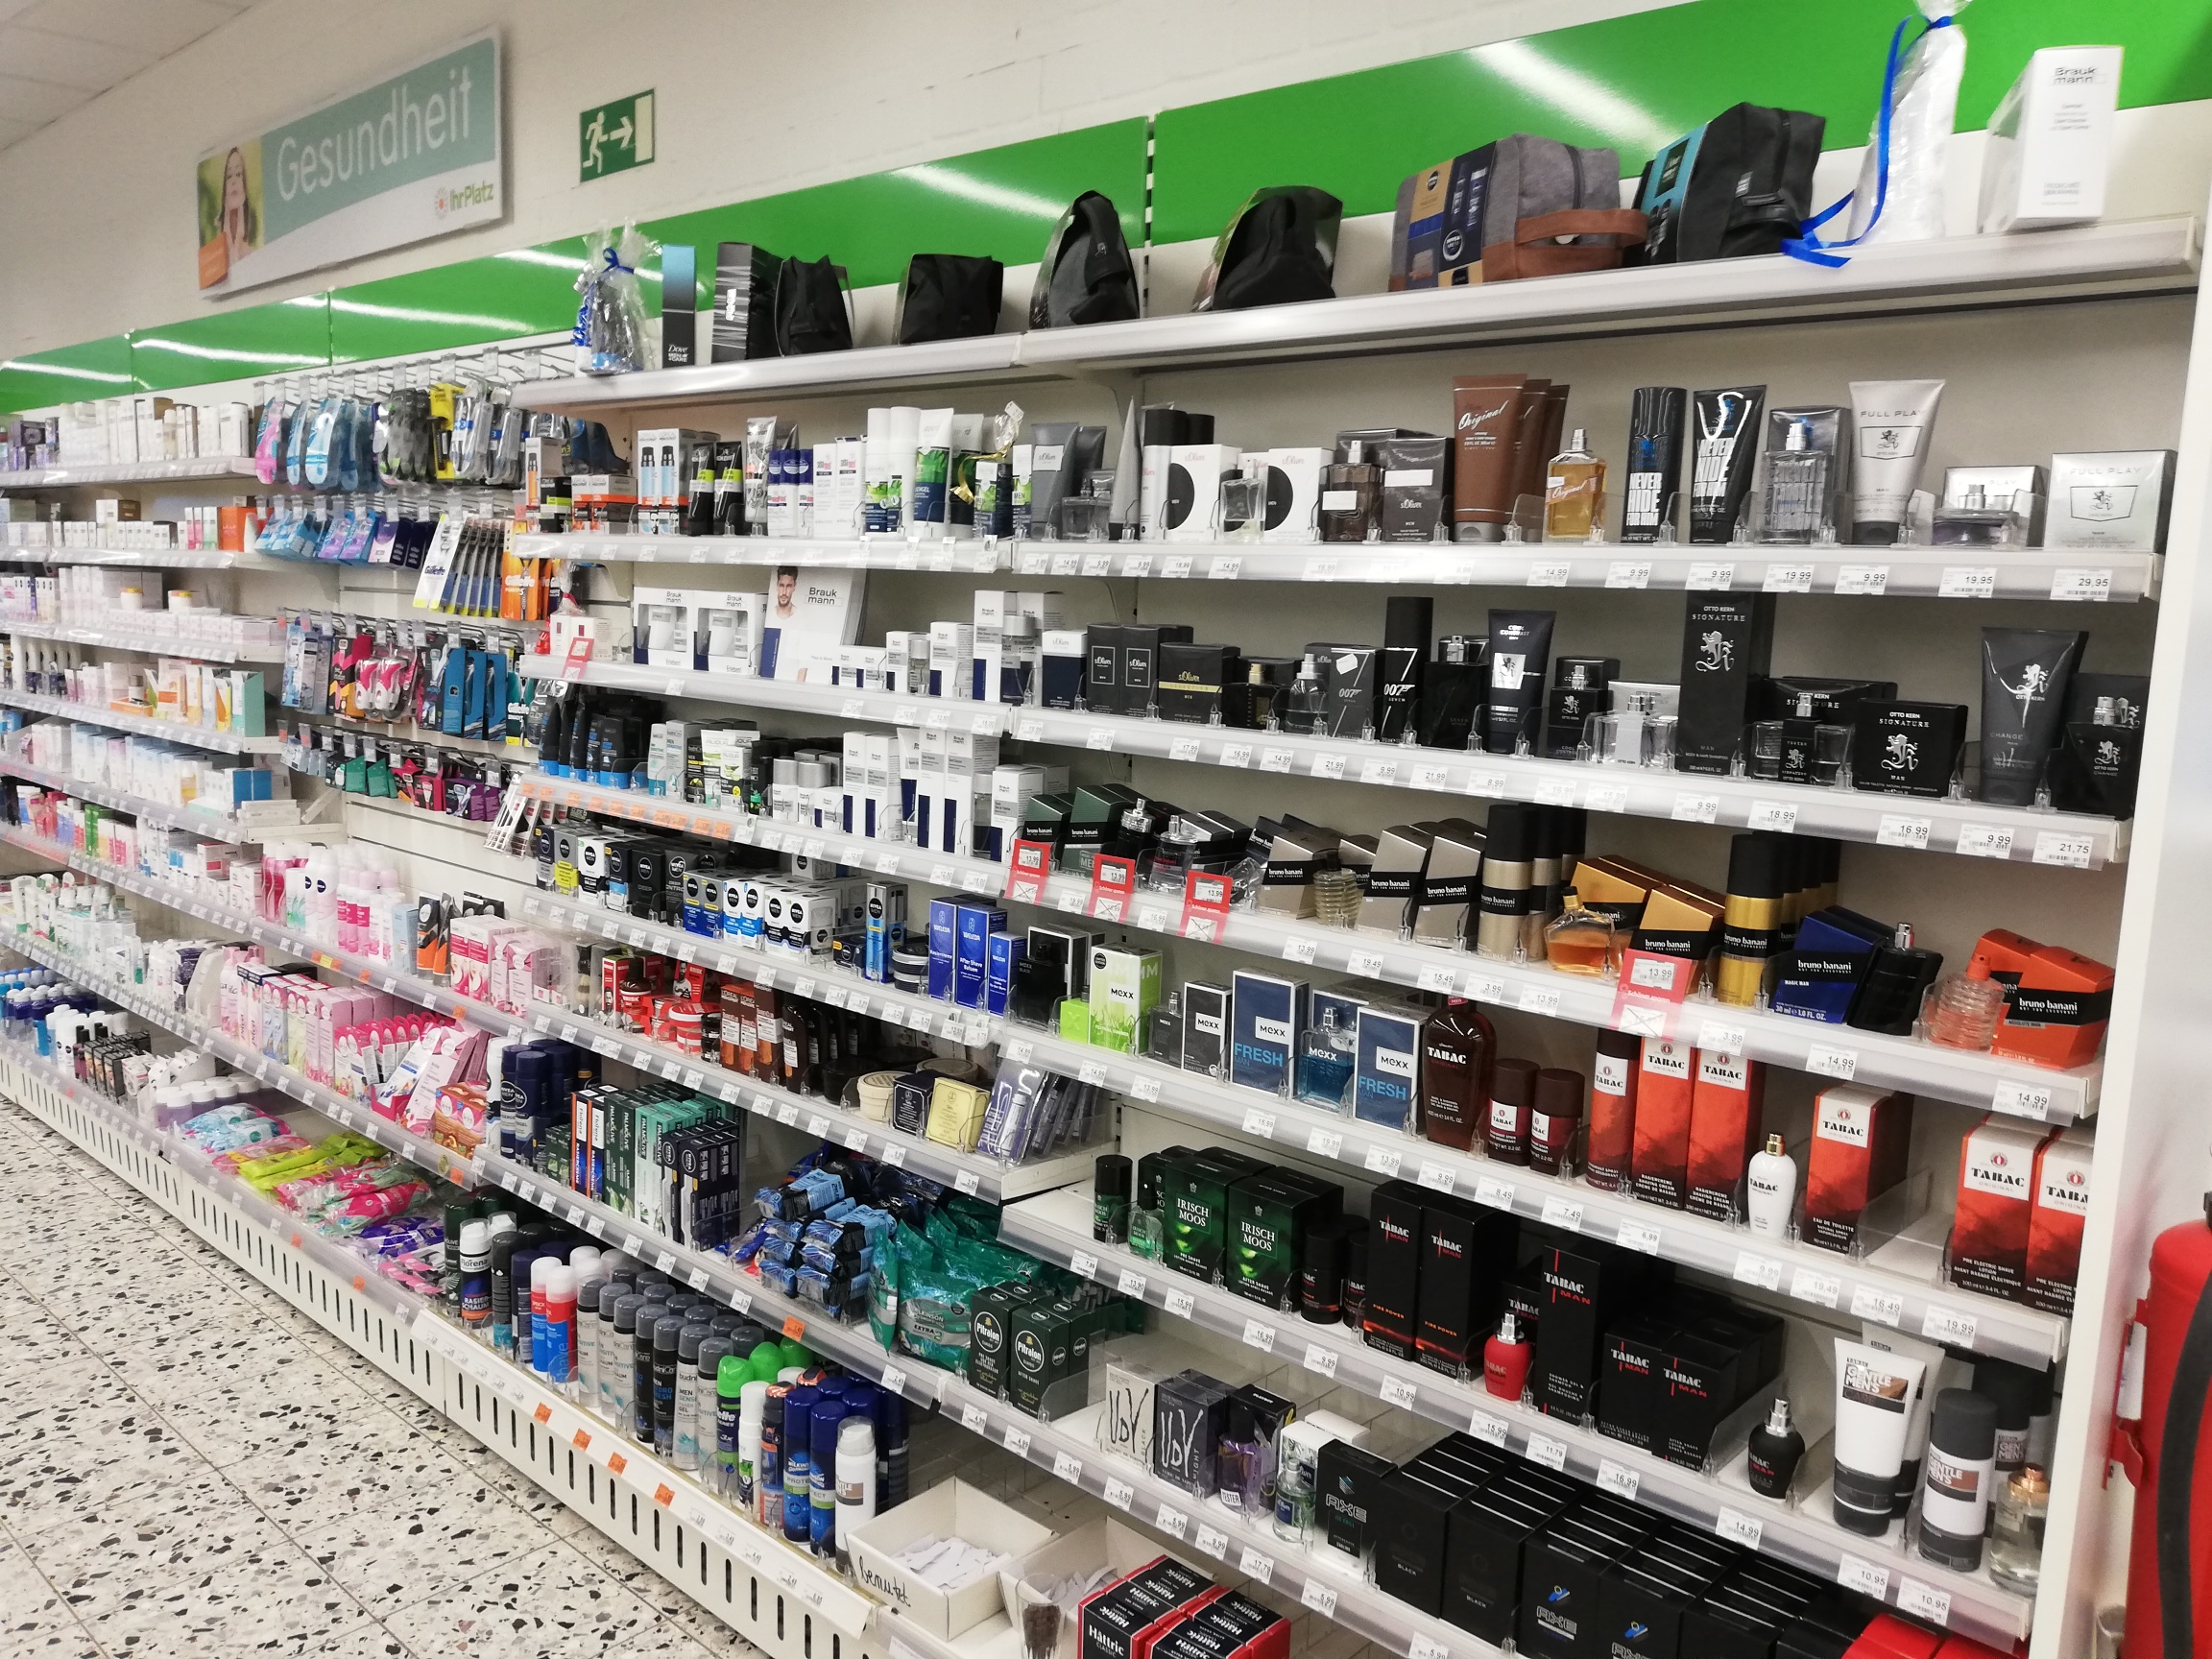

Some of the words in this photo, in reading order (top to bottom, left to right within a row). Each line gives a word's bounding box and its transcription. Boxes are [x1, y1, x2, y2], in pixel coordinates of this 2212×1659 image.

[2055, 66, 2098, 76] Brauk
[277, 66, 472, 201] Gesundheit
[449, 181, 493, 212] IhrPlatz
[668, 344, 688, 352] Dove
[1457, 400, 1510, 431] Original
[2069, 468, 2104, 476] FULL
[2107, 467, 2143, 475] PLAY
[1629, 472, 1663, 490] NEVER
[1014, 492, 1026, 500] MEN
[1551, 483, 1586, 500] Original
[1627, 489, 1661, 514] HIDE
[1641, 513, 1660, 527] HIM
[1221, 563, 1240, 572] 14.99
[1545, 567, 1568, 578] 14.99
[1629, 567, 1649, 577] 9.99
[1711, 570, 1732, 580] 9.99
[1784, 571, 1812, 581] 19.99
[1863, 573, 1887, 584] 9.99
[1964, 575, 1994, 586] 19,95
[2077, 577, 2109, 588] 29,95
[726, 594, 743, 603] Brauk
[808, 587, 838, 599] Brauk
[806, 596, 836, 606] mann
[1692, 613, 1746, 623] SIGNATURE
[1177, 670, 1201, 684] s.Oliver
[1879, 718, 1930, 729] SIGNATURE
[1989, 732, 2024, 741] CHANGE
[1425, 771, 1446, 781] 21.99
[1696, 802, 1718, 812] 9.99
[1768, 809, 1795, 821] 18.99
[1899, 825, 1929, 837] 16.99
[1986, 835, 2011, 847] 9.99
[2058, 842, 2090, 855] 21,75
[1109, 871, 1127, 881] 13.99
[1268, 867, 1284, 876] bruno
[1284, 868, 1304, 877] banani
[1371, 878, 1389, 889] bruno
[1389, 879, 1410, 889] banani
[1427, 886, 1445, 895] bruno
[1445, 885, 1467, 895] banani
[1207, 888, 1224, 899] 13.99
[1645, 939, 1666, 949] bruno
[1666, 940, 1691, 950] banani
[1725, 933, 1742, 944] bruno
[1742, 936, 1767, 947] banani
[1297, 943, 1315, 955] 13.99
[1362, 956, 1382, 969] 19.49
[1797, 959, 1822, 971] bruno
[1823, 960, 1852, 973] banani
[1433, 972, 1455, 984] 15.49
[1648, 966, 1673, 978] 13.99
[1484, 982, 1502, 994] 3.99
[1536, 993, 1558, 1006] 13.99
[2018, 997, 2045, 1009] bruno
[2046, 999, 2079, 1012] banani
[1721, 1031, 1743, 1044] 3.99
[1235, 1043, 1285, 1069] FRESH
[1427, 1046, 1468, 1066] TABAC
[1647, 1054, 1686, 1070] TABAC
[1827, 1053, 1855, 1069] 14.99
[1703, 1064, 1743, 1081] TABAC
[1358, 1075, 1407, 1101] FRESH
[1595, 1073, 1624, 1089] TABAC
[1142, 1083, 1159, 1094] 13.99
[2017, 1092, 2049, 1105] 14.99
[1257, 1118, 1274, 1129] 15.99
[1493, 1116, 1514, 1127] TABAC
[1822, 1119, 1864, 1139] TABAC
[1321, 1136, 1340, 1148] 19.99
[1380, 1154, 1400, 1167] 13.99
[1437, 1173, 1454, 1185] 9.99
[1971, 1166, 2026, 1189] TABAC
[1748, 1177, 1779, 1193] TABAC
[1496, 1188, 1513, 1200] 8.49
[1177, 1197, 1210, 1218] IRISCH
[1563, 1207, 1582, 1220] 7.49
[1178, 1210, 1207, 1228] MOOS
[1240, 1220, 1276, 1242] IRISCH
[1379, 1218, 1409, 1239] TABAC
[1242, 1233, 1273, 1252] MOOS
[1641, 1230, 1659, 1242] 6.99
[1431, 1234, 1462, 1254] TABAC
[461, 1257, 490, 1271] Florena
[1759, 1263, 1780, 1278] 9.99
[1543, 1270, 1585, 1295] TABAC
[1812, 1278, 1839, 1295] 19.49
[1559, 1288, 1592, 1306] MAN
[1872, 1296, 1901, 1313] 16.49
[913, 1323, 936, 1337] EXTRA
[934, 1330, 944, 1343] 2
[976, 1320, 1001, 1342] Pitralon
[1944, 1318, 1975, 1335] 19.99
[1017, 1340, 1043, 1361] Pitralon
[1321, 1355, 1336, 1368] 9.99
[1611, 1347, 1650, 1370] TABAC
[1663, 1366, 1702, 1389] TABAC
[1847, 1364, 1893, 1388] GENTLE
[679, 1388, 693, 1397] MEN
[1395, 1385, 1416, 1402] 10.99
[1678, 1382, 1708, 1399] MAN
[1485, 1421, 1508, 1438] 15.99
[1546, 1445, 1564, 1458] 11.79
[1614, 1471, 1638, 1489] 16.99
[1220, 1489, 1242, 1507] TESTER
[1325, 1492, 1367, 1525] AXE
[1734, 1519, 1760, 1538] 14.99
[1252, 1557, 1273, 1575] 17.79
[1396, 1561, 1418, 1577] BLACK
[1860, 1568, 1887, 1587] 10.95
[1465, 1595, 1488, 1610] BLACK
[1920, 1593, 1948, 1612] 10.95
[1536, 1605, 1577, 1636] AXE
